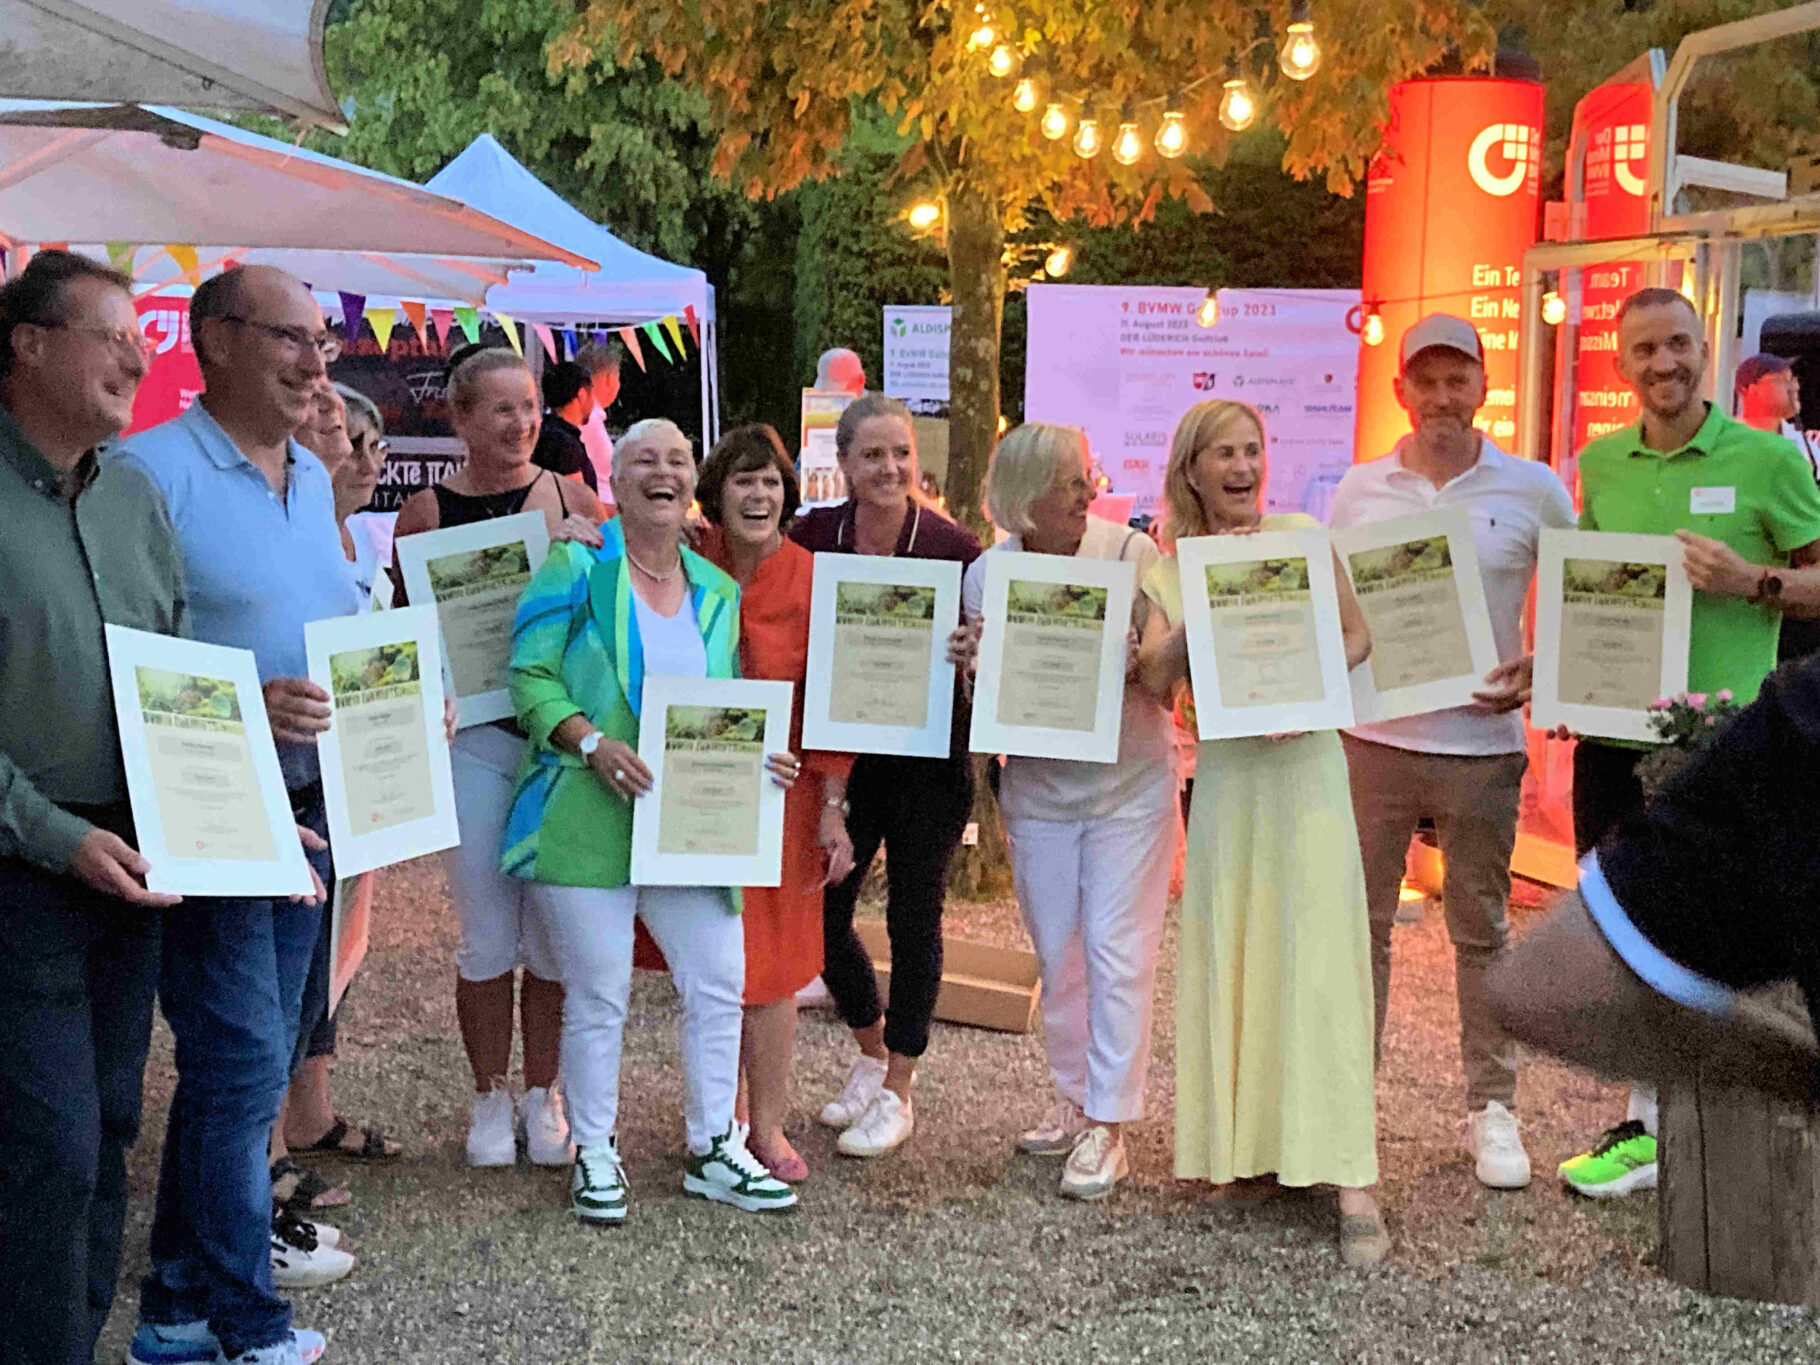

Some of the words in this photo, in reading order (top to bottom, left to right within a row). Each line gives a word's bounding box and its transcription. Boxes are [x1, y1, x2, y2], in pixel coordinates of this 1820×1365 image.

[1472, 264, 1500, 286] Ein
[1138, 302, 1182, 315] BVMW
[1244, 303, 1277, 316] 2023
[1471, 296, 1499, 318] Ein
[1133, 319, 1164, 330] August
